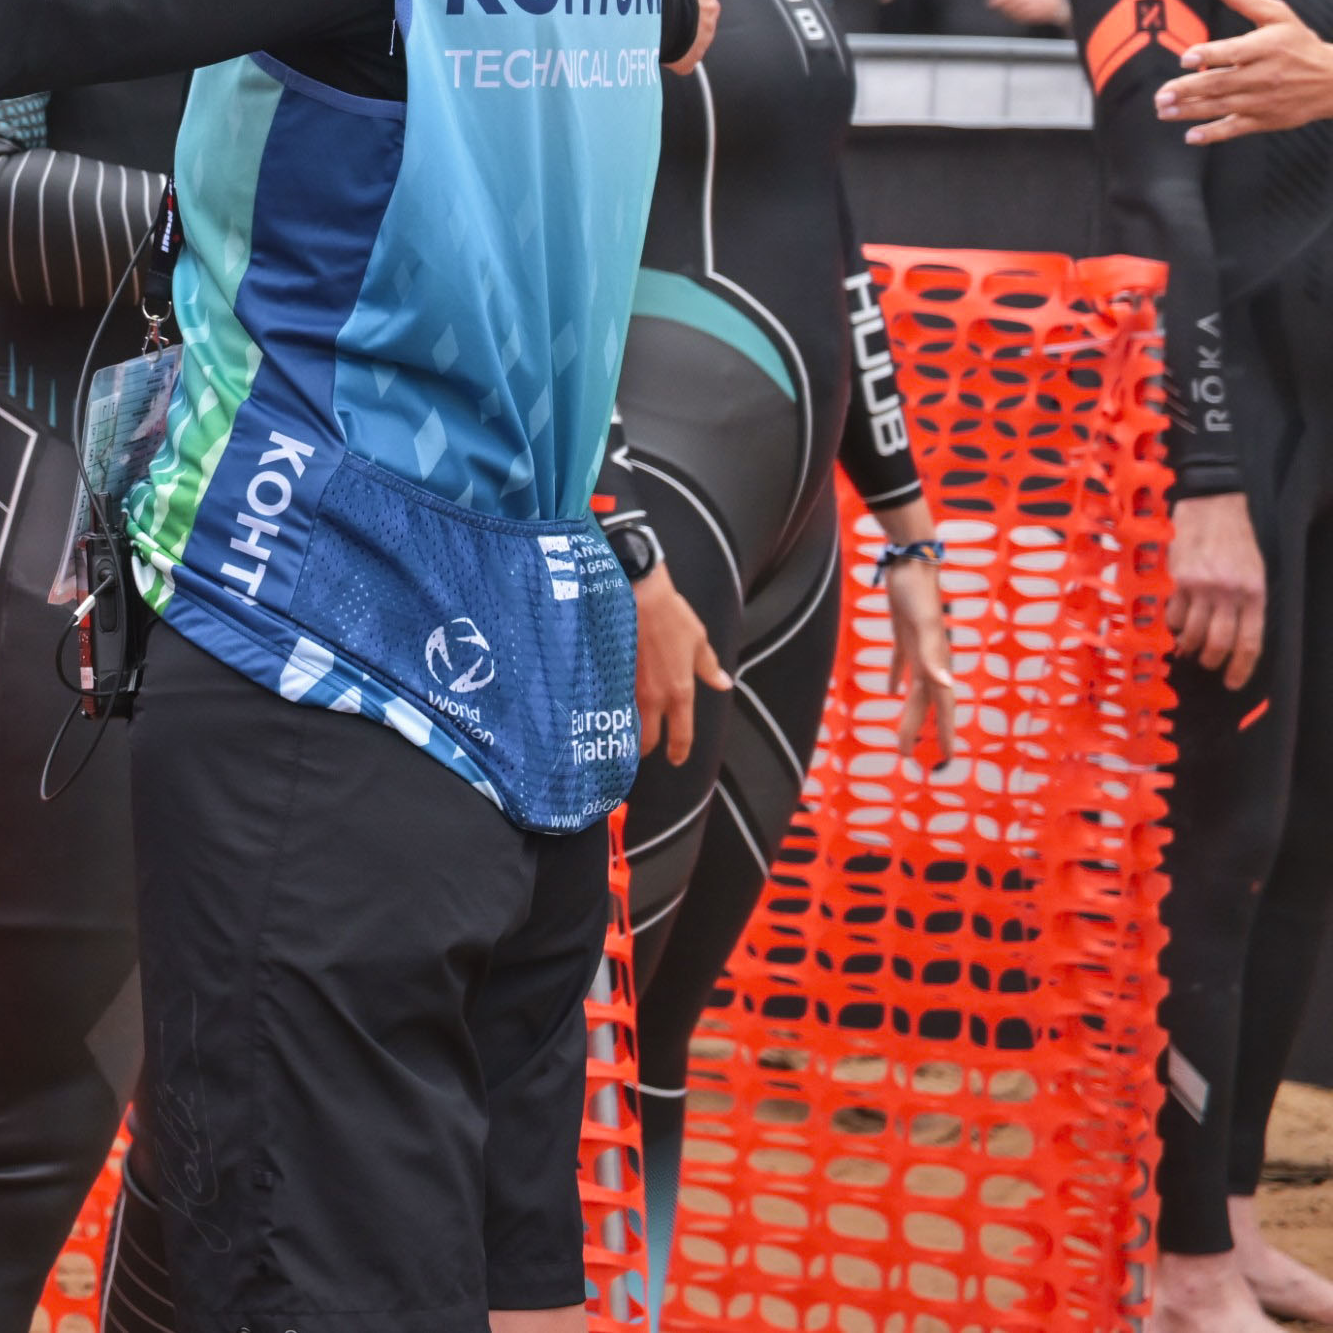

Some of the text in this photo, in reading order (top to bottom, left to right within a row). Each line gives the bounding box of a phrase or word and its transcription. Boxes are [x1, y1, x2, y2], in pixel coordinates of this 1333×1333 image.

[445, 49, 613, 90] TECHNICAL
[843, 271, 910, 457] HUUB
[429, 690, 481, 723] World
[571, 707, 633, 737] Europe
[570, 732, 638, 766] Triathl
